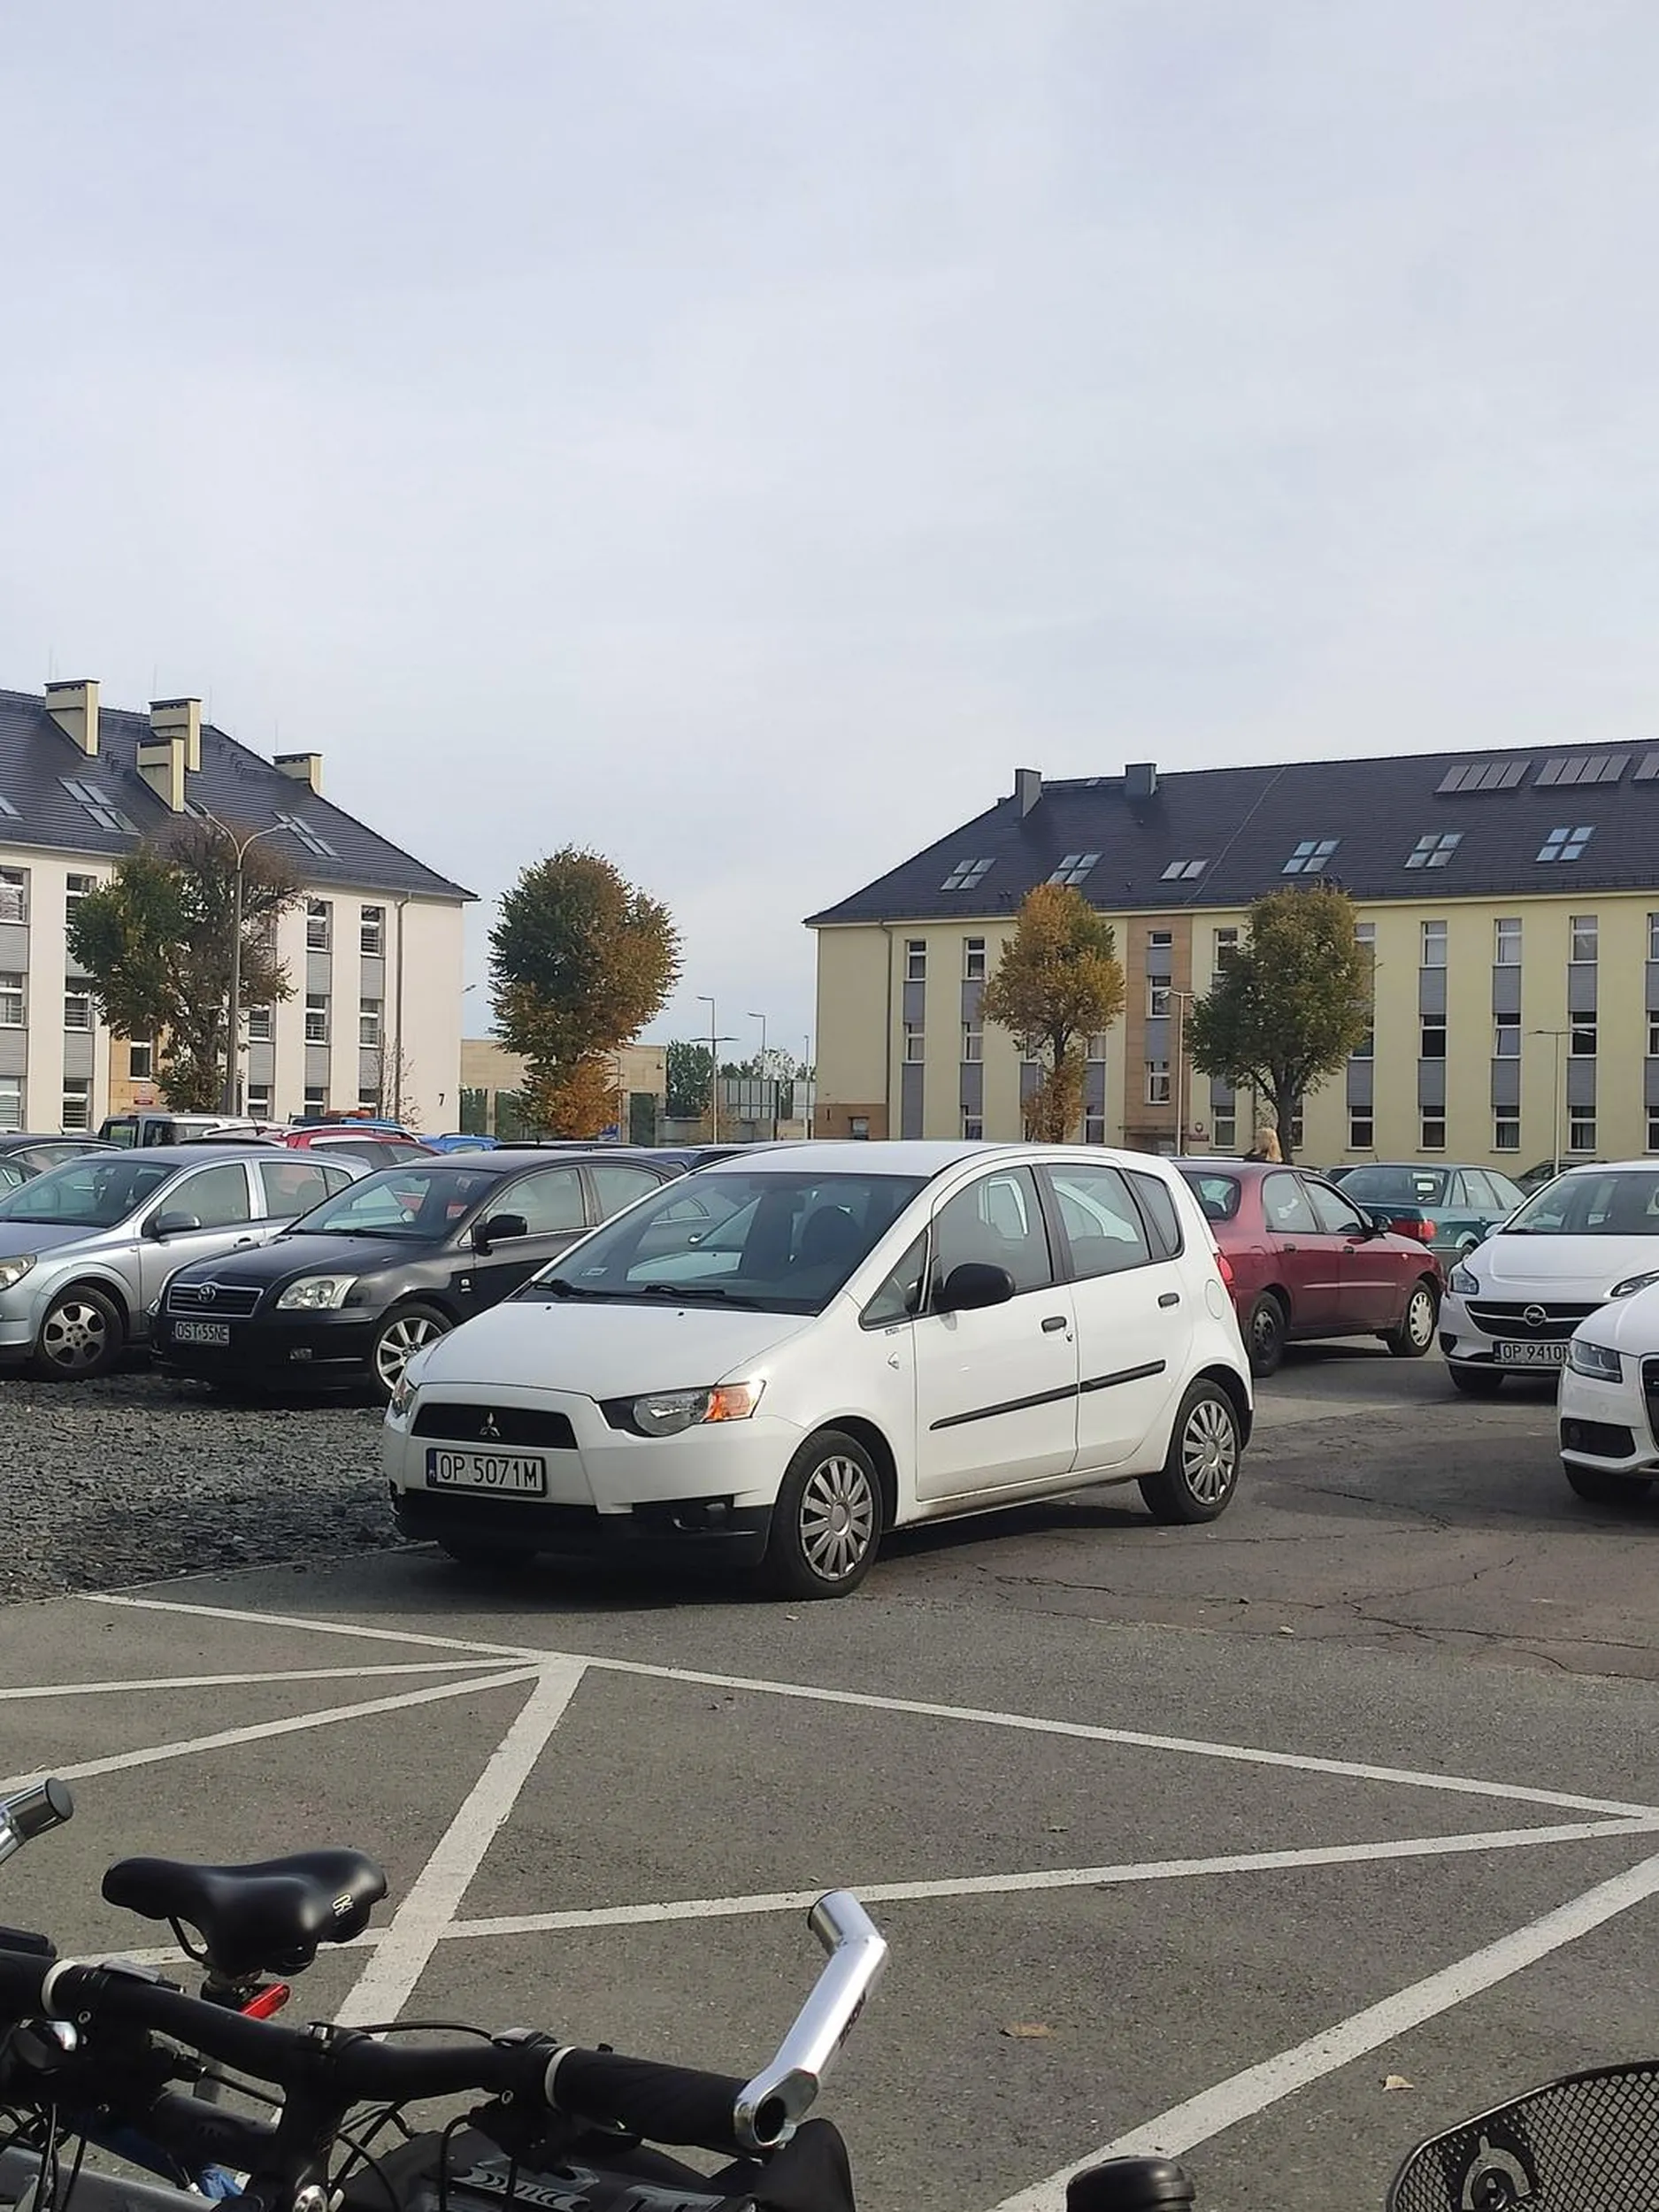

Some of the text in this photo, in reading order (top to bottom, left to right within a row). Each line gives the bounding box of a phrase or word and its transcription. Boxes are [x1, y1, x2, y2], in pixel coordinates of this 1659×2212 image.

[438, 1093, 445, 1106] 7
[177, 1323, 199, 1339] OST
[1503, 1345, 1522, 1359] OP
[441, 1455, 537, 1487] OP 5071M
